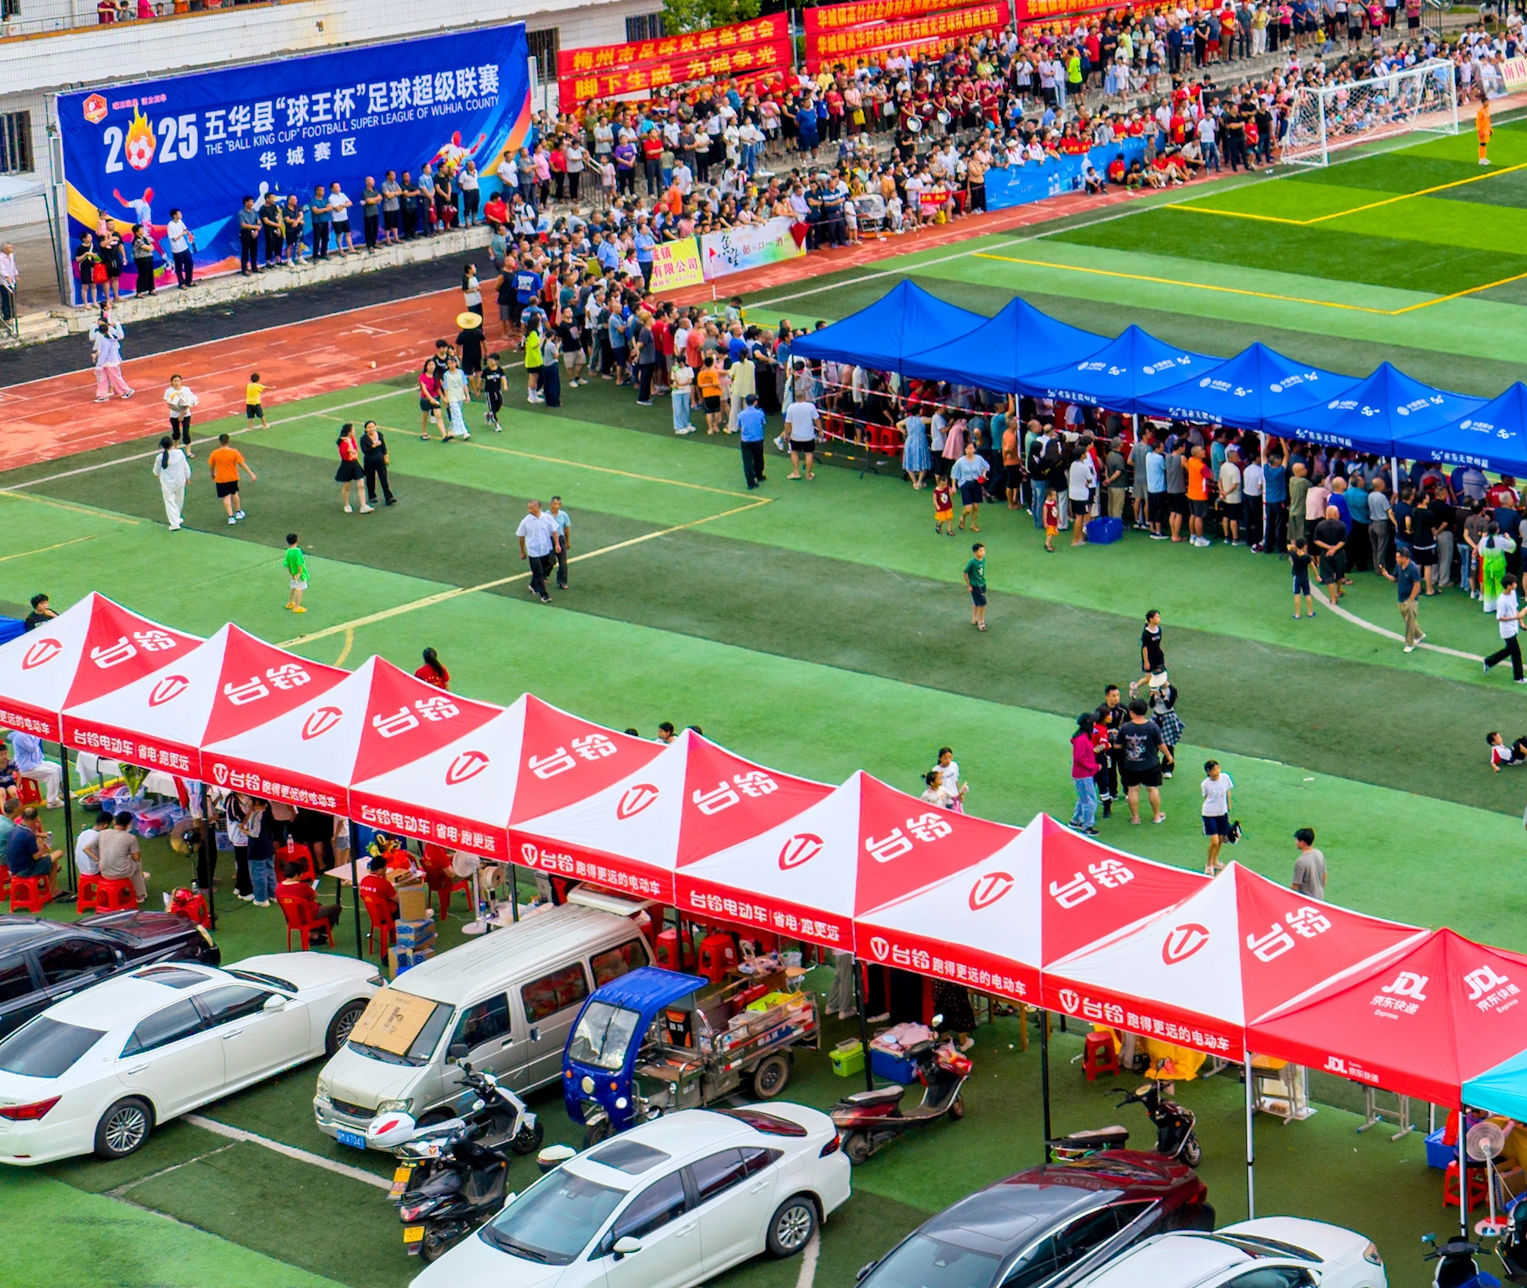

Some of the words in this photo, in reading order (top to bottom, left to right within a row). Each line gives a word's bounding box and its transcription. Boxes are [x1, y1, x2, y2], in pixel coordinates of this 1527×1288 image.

[205, 143, 223, 155] THE
[253, 133, 275, 147] KING
[302, 120, 348, 138] FOOTBALL
[351, 115, 379, 131] SUPER
[381, 111, 415, 125] LEAGUE
[417, 108, 428, 119] OF
[431, 101, 463, 117] WUHUA
[465, 95, 499, 110] COUNTY
[260, 137, 357, 170] 华城赛区
[652, 257, 698, 279] 有限公司
[91, 630, 176, 668] 台铃
[224, 663, 311, 705] 台铃
[372, 695, 460, 738] 台铃
[73, 729, 134, 756] 台铃电动车
[528, 733, 617, 779] 台铃
[230, 770, 260, 792] 台铃
[261, 780, 337, 809] 跑得更远的电动车
[692, 770, 778, 815] 台铃
[361, 805, 431, 834] 台铃电动车
[865, 812, 952, 863] 台铃
[540, 850, 574, 873] 台铃
[576, 861, 660, 895] 跑得更远的电动车
[1049, 858, 1135, 908] 台铃
[690, 890, 767, 923] 台铃电动车
[1247, 906, 1331, 962] 台铃
[892, 944, 930, 970] 台铃
[932, 957, 1026, 996] 跑得更远的电动车
[1381, 971, 1429, 1001] JDL
[1463, 965, 1509, 1000] JDL
[1369, 994, 1420, 1015] 京东快递
[1374, 1009, 1399, 1020] Express
[1476, 983, 1520, 1013] 京东快递
[1496, 999, 1519, 1013] Express
[1083, 997, 1124, 1024] 台铃
[1127, 1011, 1229, 1052] 跑得更远的电动车
[1324, 1055, 1347, 1074] JDL
[1349, 1066, 1379, 1083] 京东快递
